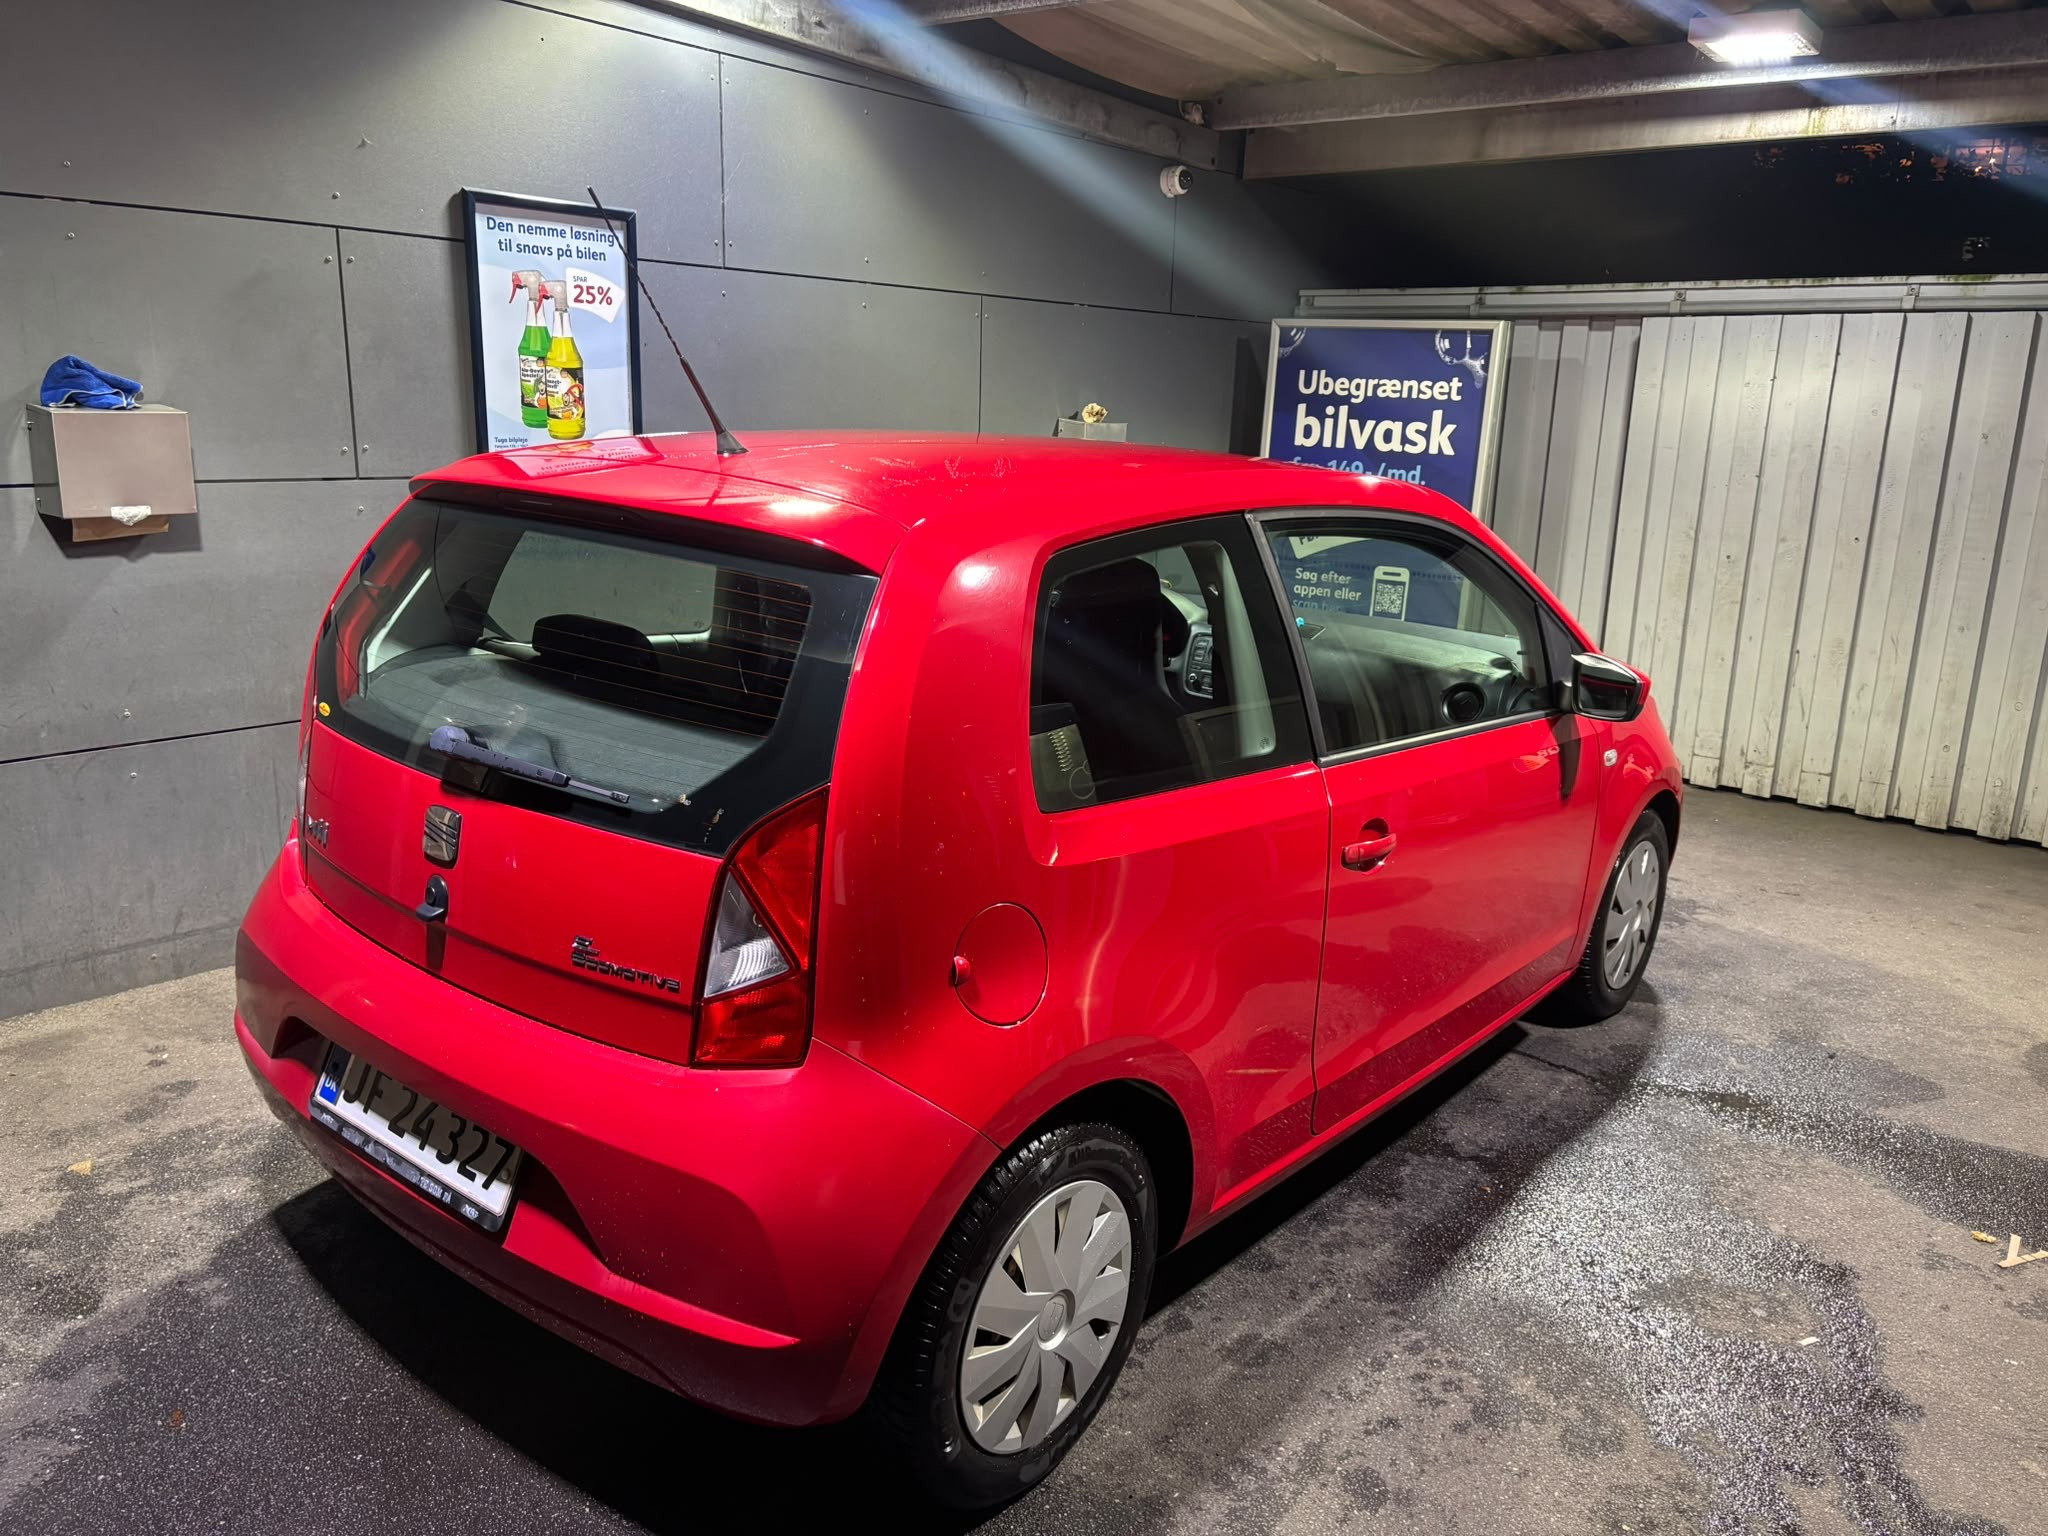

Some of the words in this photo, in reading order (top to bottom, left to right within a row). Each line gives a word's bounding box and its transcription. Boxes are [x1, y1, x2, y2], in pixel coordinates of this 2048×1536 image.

[486, 217, 514, 233] Den
[518, 222, 567, 239] nemme
[570, 224, 615, 247] løsning
[497, 238, 513, 252] til
[515, 241, 553, 257] snavs
[556, 244, 573, 260] på
[576, 246, 607, 262] bilen
[572, 275, 588, 283] SPAR
[572, 284, 613, 306] 25%
[1298, 369, 1463, 404] Ubegrænset
[1294, 403, 1457, 456] bilvask
[1295, 567, 1318, 583] Søg
[1321, 571, 1352, 585] efter
[1293, 584, 1331, 599] appen
[1334, 587, 1362, 601] eller
